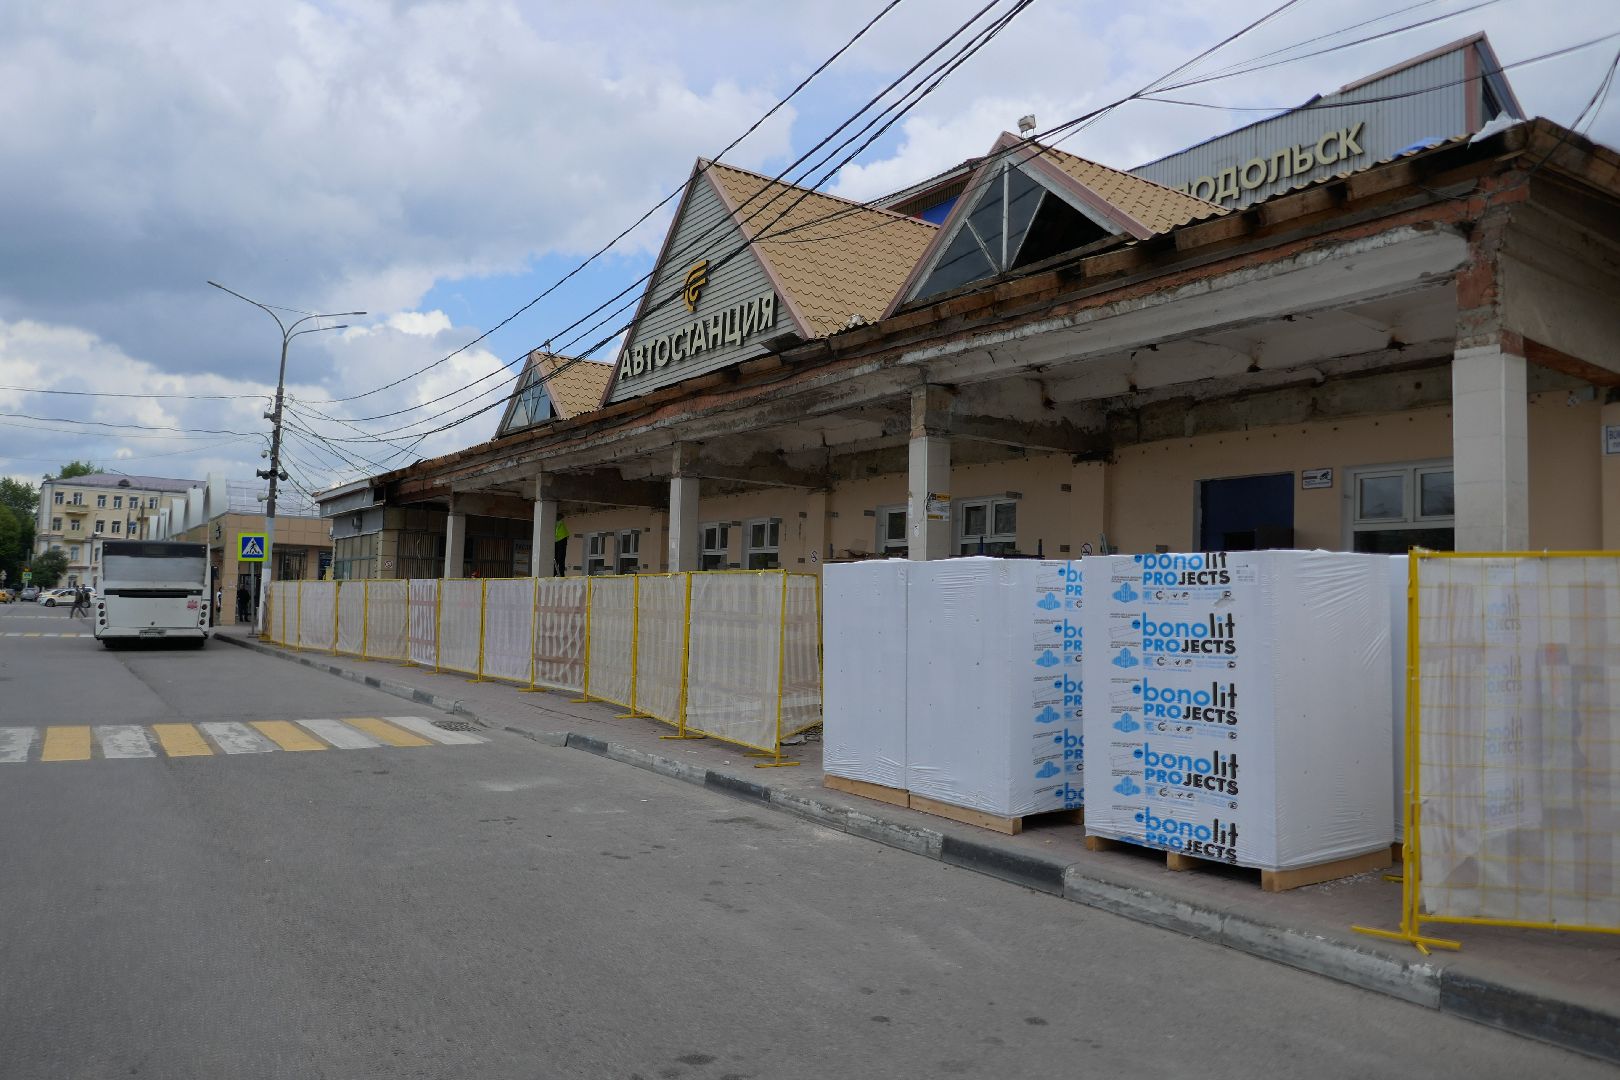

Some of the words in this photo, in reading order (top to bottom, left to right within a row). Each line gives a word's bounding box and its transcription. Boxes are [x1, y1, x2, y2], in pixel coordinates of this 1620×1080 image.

[619, 291, 777, 380] АВТОСТАНЦИЯ
[1143, 570, 1231, 586] PROJECTS
[1142, 612, 1235, 638] bonolit
[1142, 638, 1237, 655] PROJECTS
[1143, 677, 1238, 710] bonolit
[1143, 703, 1238, 726] PROJECTS
[1144, 742, 1239, 780] bonolit
[1144, 768, 1239, 796] PROJECTS
[1145, 806, 1239, 848] bonolit
